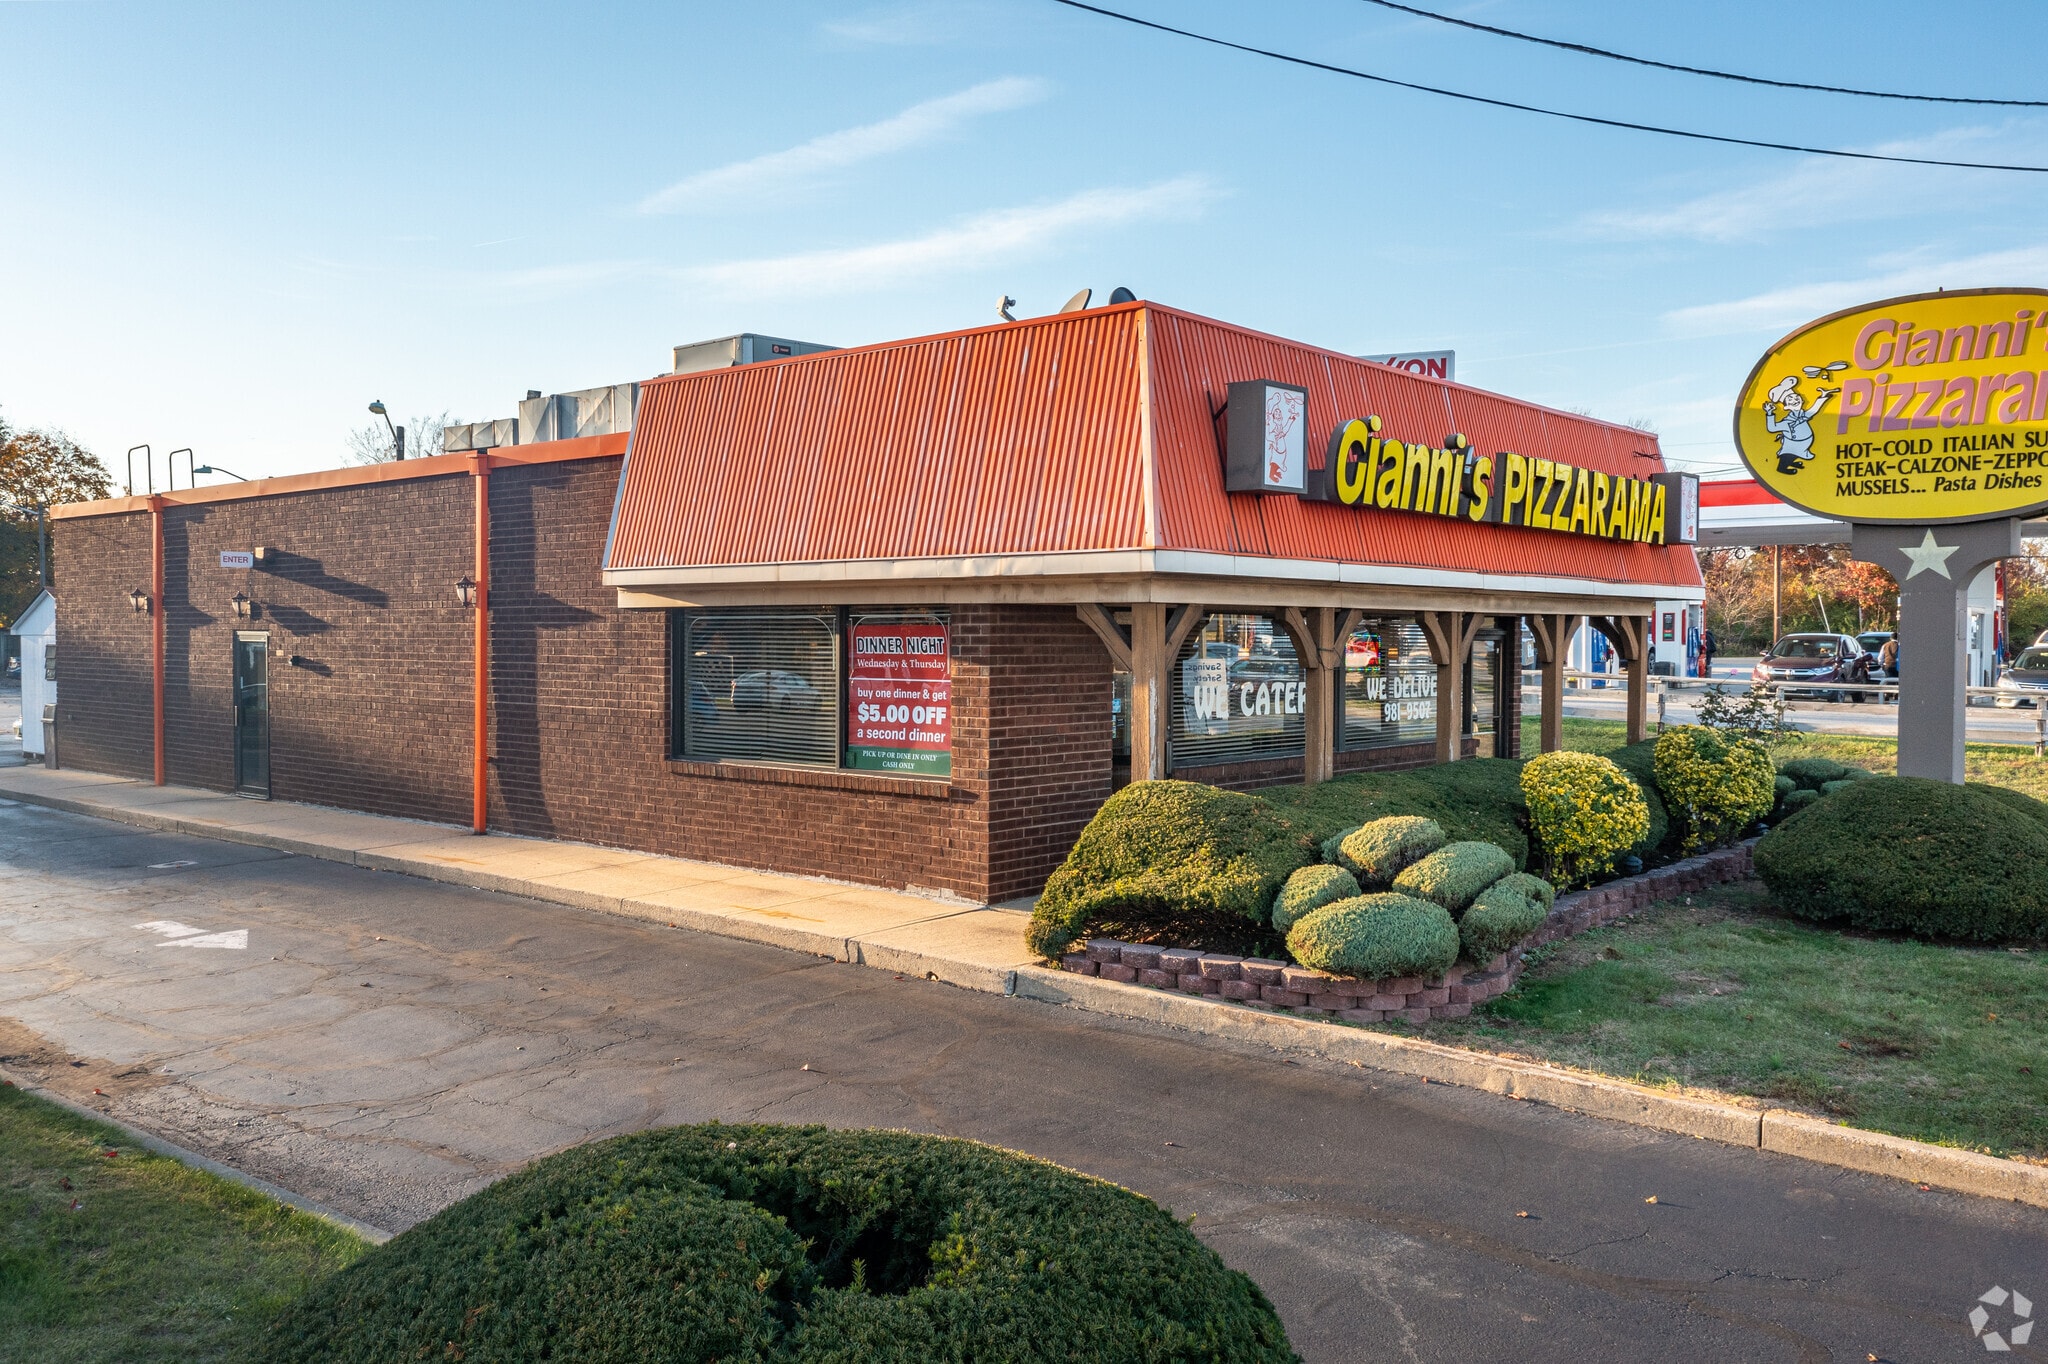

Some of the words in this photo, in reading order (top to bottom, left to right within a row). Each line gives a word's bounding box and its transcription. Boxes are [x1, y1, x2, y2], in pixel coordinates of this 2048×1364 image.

[1853, 309, 2048, 371] Gianni'
[1379, 357, 1447, 378] ON
[1836, 438, 1933, 460] HOT-COLD
[1943, 432, 2015, 453] ITALIAN
[1336, 414, 1492, 522] Gianni's
[1502, 453, 1666, 545] PIZZARAMA
[1836, 477, 1926, 496] MUSSELS...
[1934, 475, 1976, 493] Pasta
[1983, 471, 2042, 490] Dishes
[222, 555, 249, 564] ENTER
[856, 637, 904, 654] DINNER
[906, 637, 944, 655] NIGHT
[857, 658, 899, 671] Wednesday
[901, 660, 908, 668] &
[910, 659, 946, 671] Thursday
[857, 687, 873, 699] buy
[875, 690, 891, 698] one
[893, 688, 920, 699] dinner
[922, 688, 930, 699] &
[932, 690, 947, 702] get
[1366, 677, 1387, 700] WE
[1194, 684, 1229, 720] WE
[857, 701, 909, 724] $5.00
[912, 705, 947, 725] OFF
[857, 728, 863, 738] a
[866, 728, 906, 740] second
[909, 728, 946, 743] dinner
[898, 762, 915, 770] ONLY
[920, 754, 938, 762] ONLY
